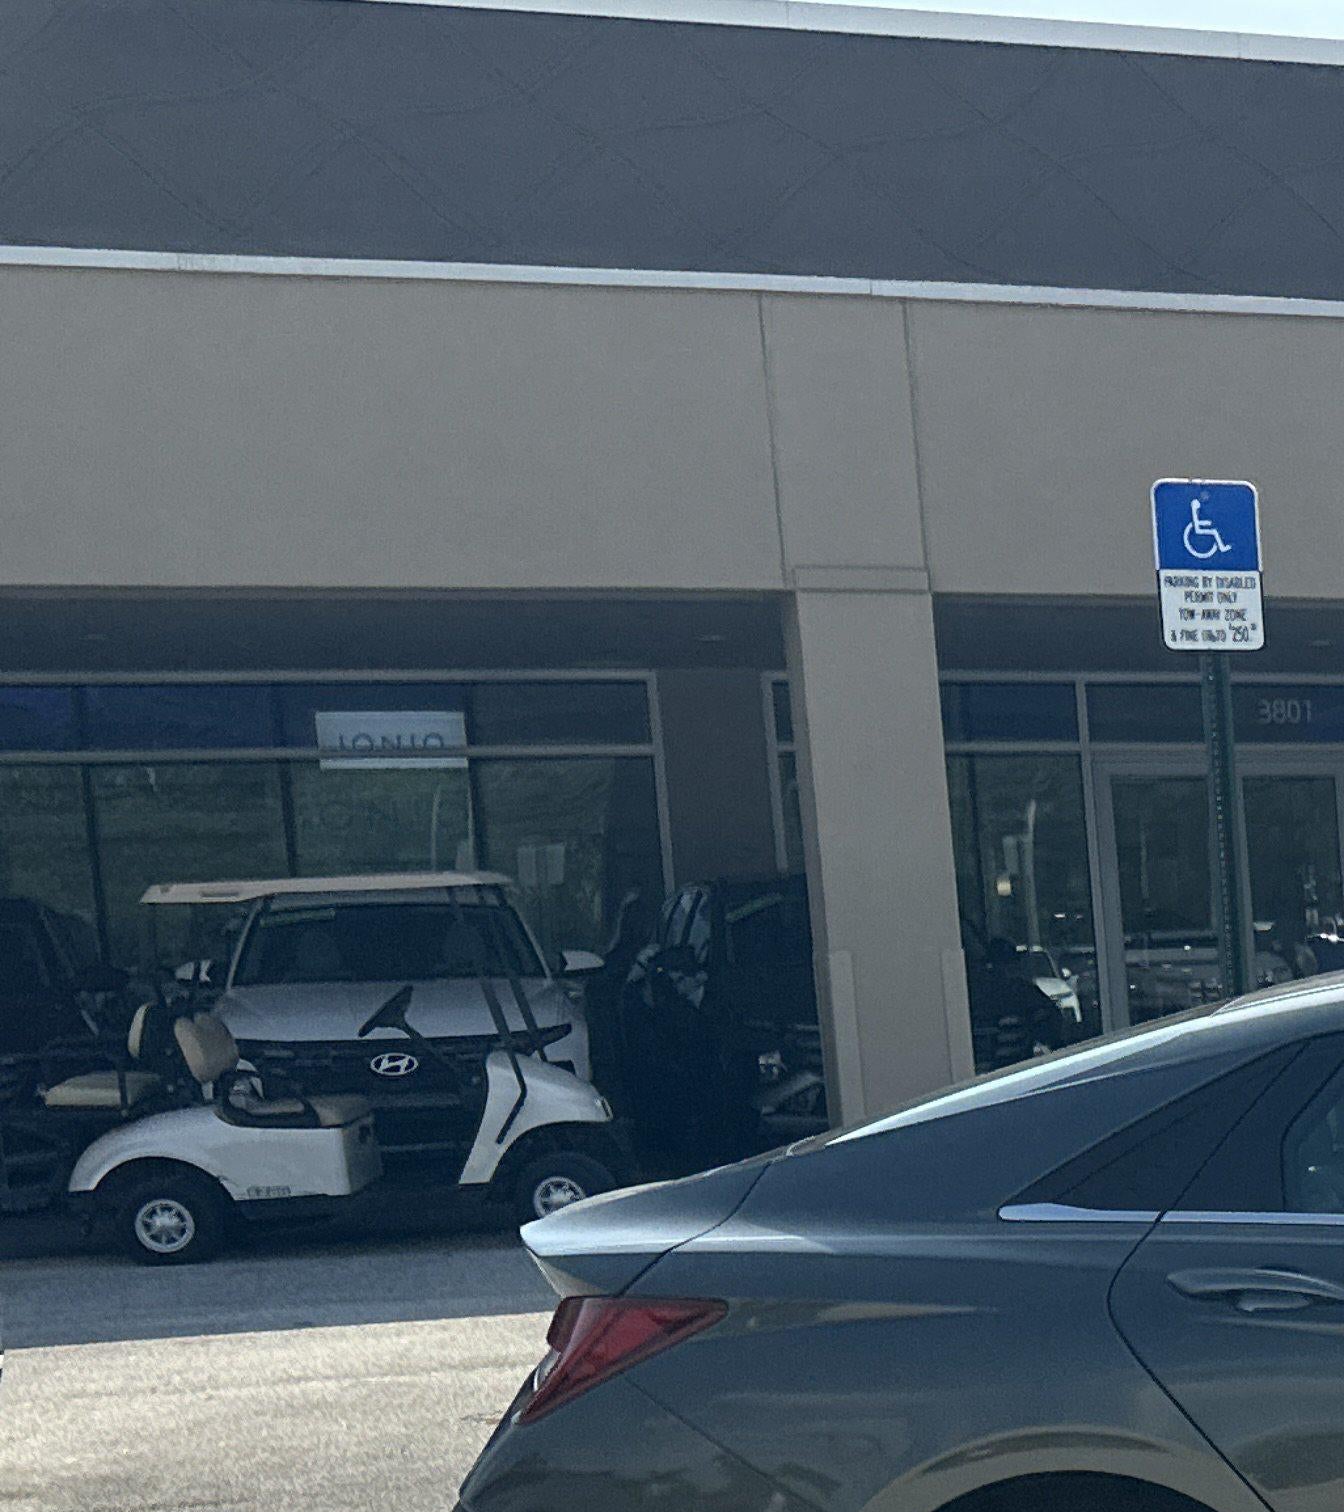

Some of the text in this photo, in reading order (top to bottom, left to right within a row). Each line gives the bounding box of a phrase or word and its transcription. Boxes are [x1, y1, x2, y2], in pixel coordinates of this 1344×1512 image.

[1164, 575, 1199, 589] PARKING
[1215, 576, 1256, 590] DISABLED
[1258, 699, 1312, 723] 3801
